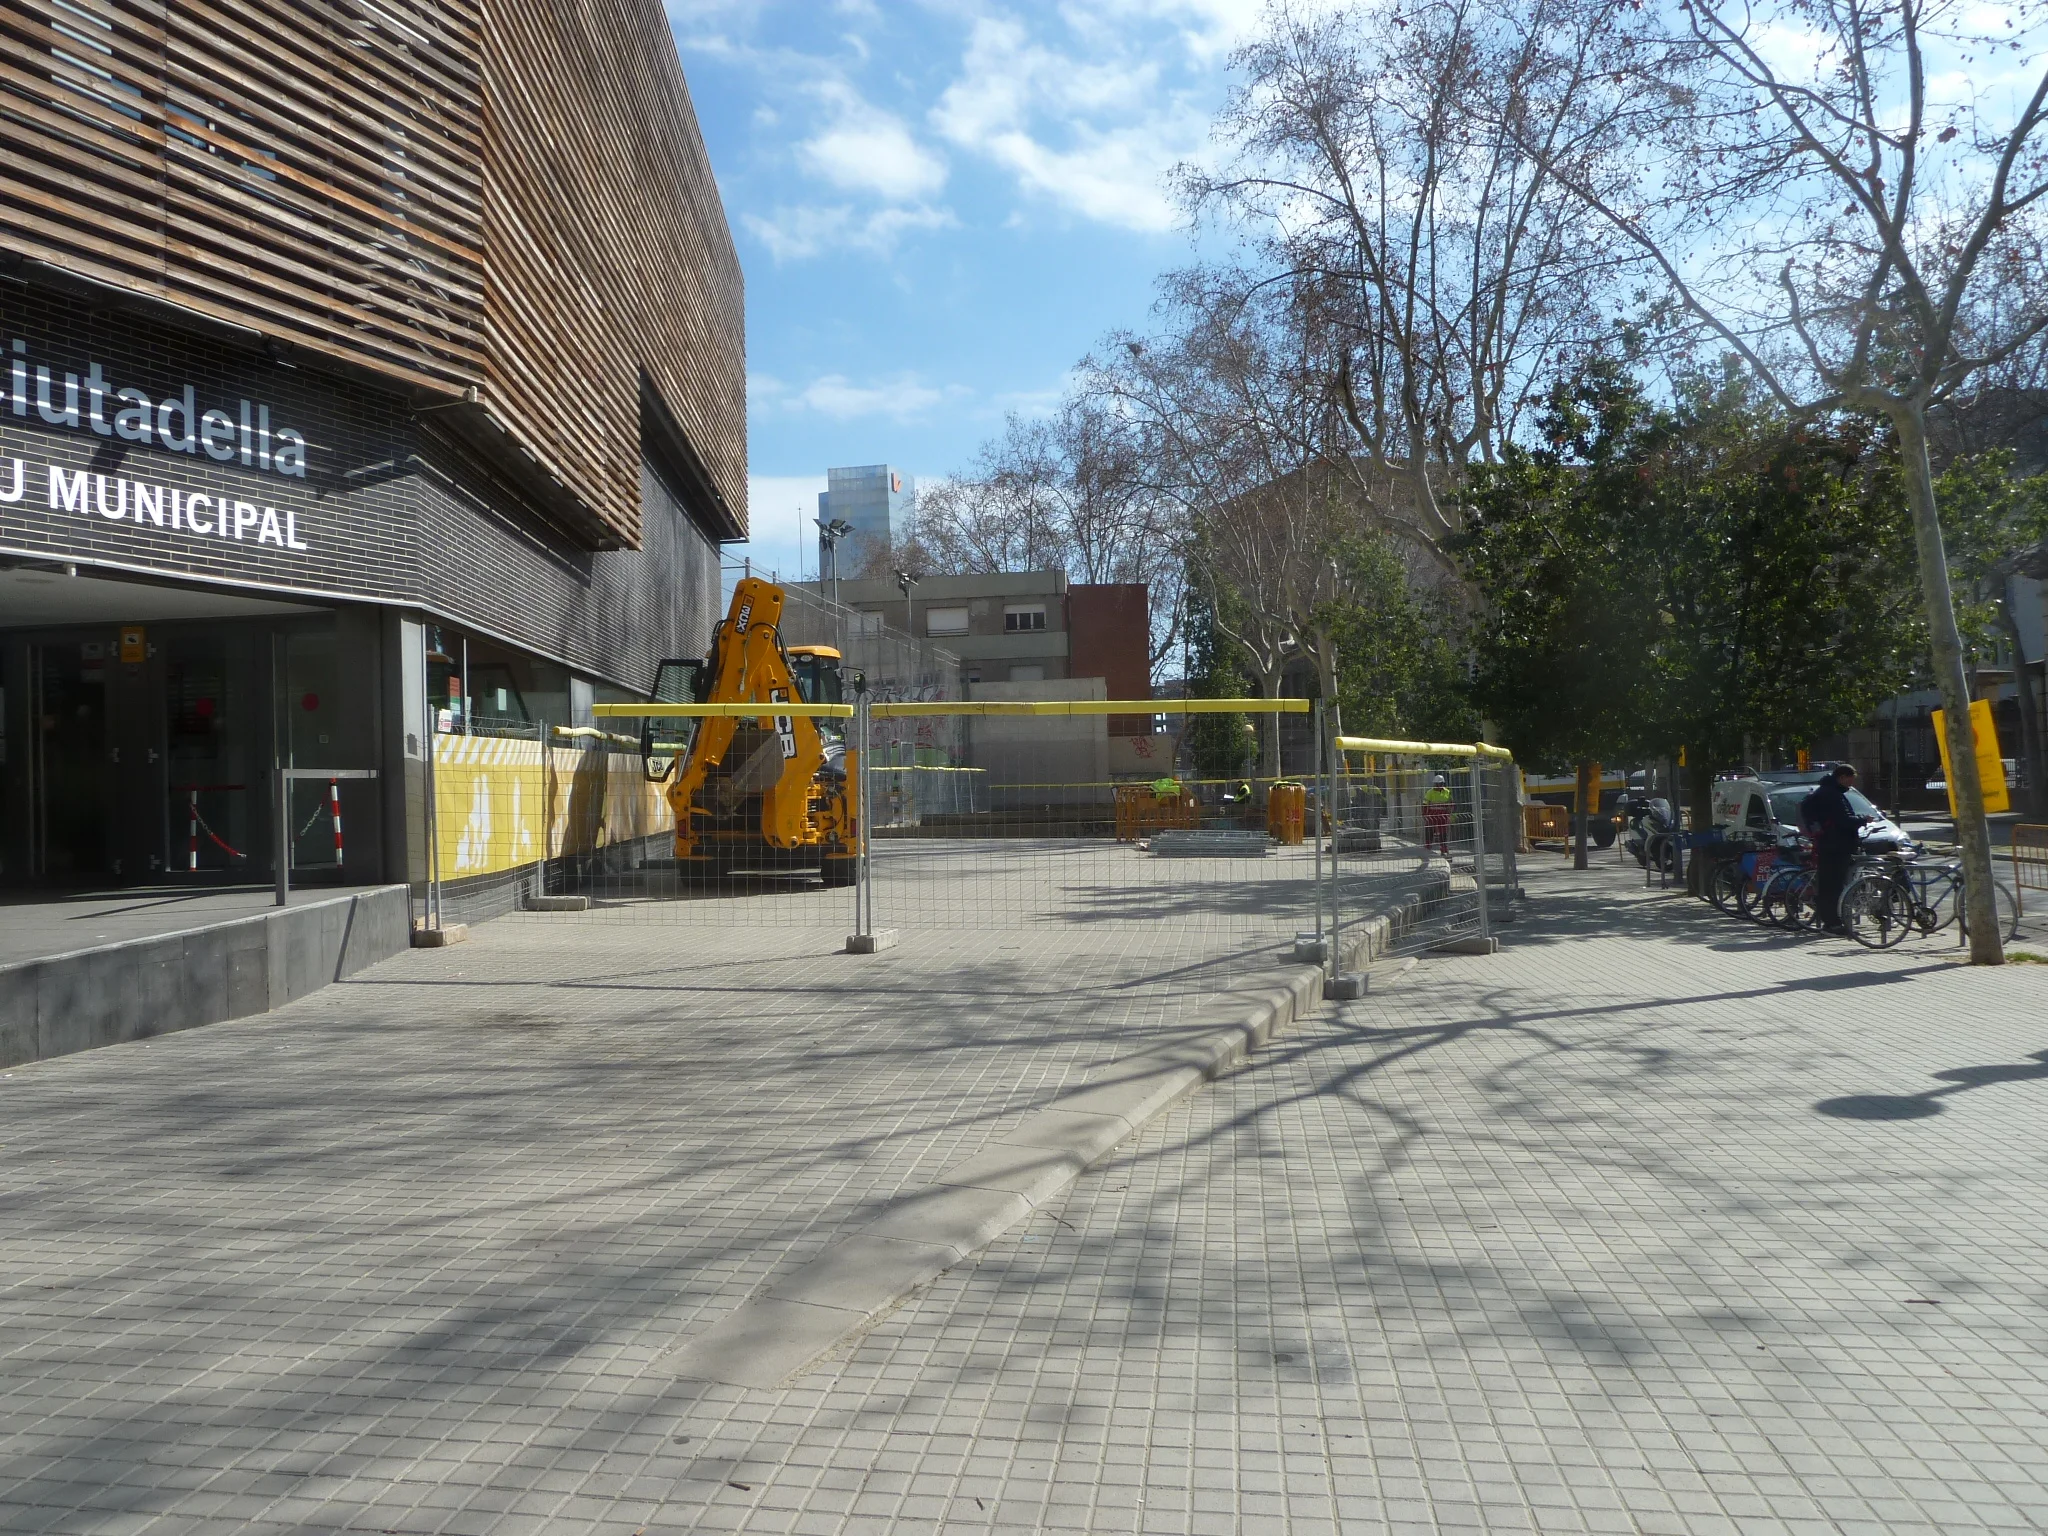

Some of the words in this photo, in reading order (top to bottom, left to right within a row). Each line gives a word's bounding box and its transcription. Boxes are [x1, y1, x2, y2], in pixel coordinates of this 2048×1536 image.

[0, 338, 306, 479] iutadella
[49, 464, 307, 551] MUNICIPAL
[770, 689, 796, 758] JCB
